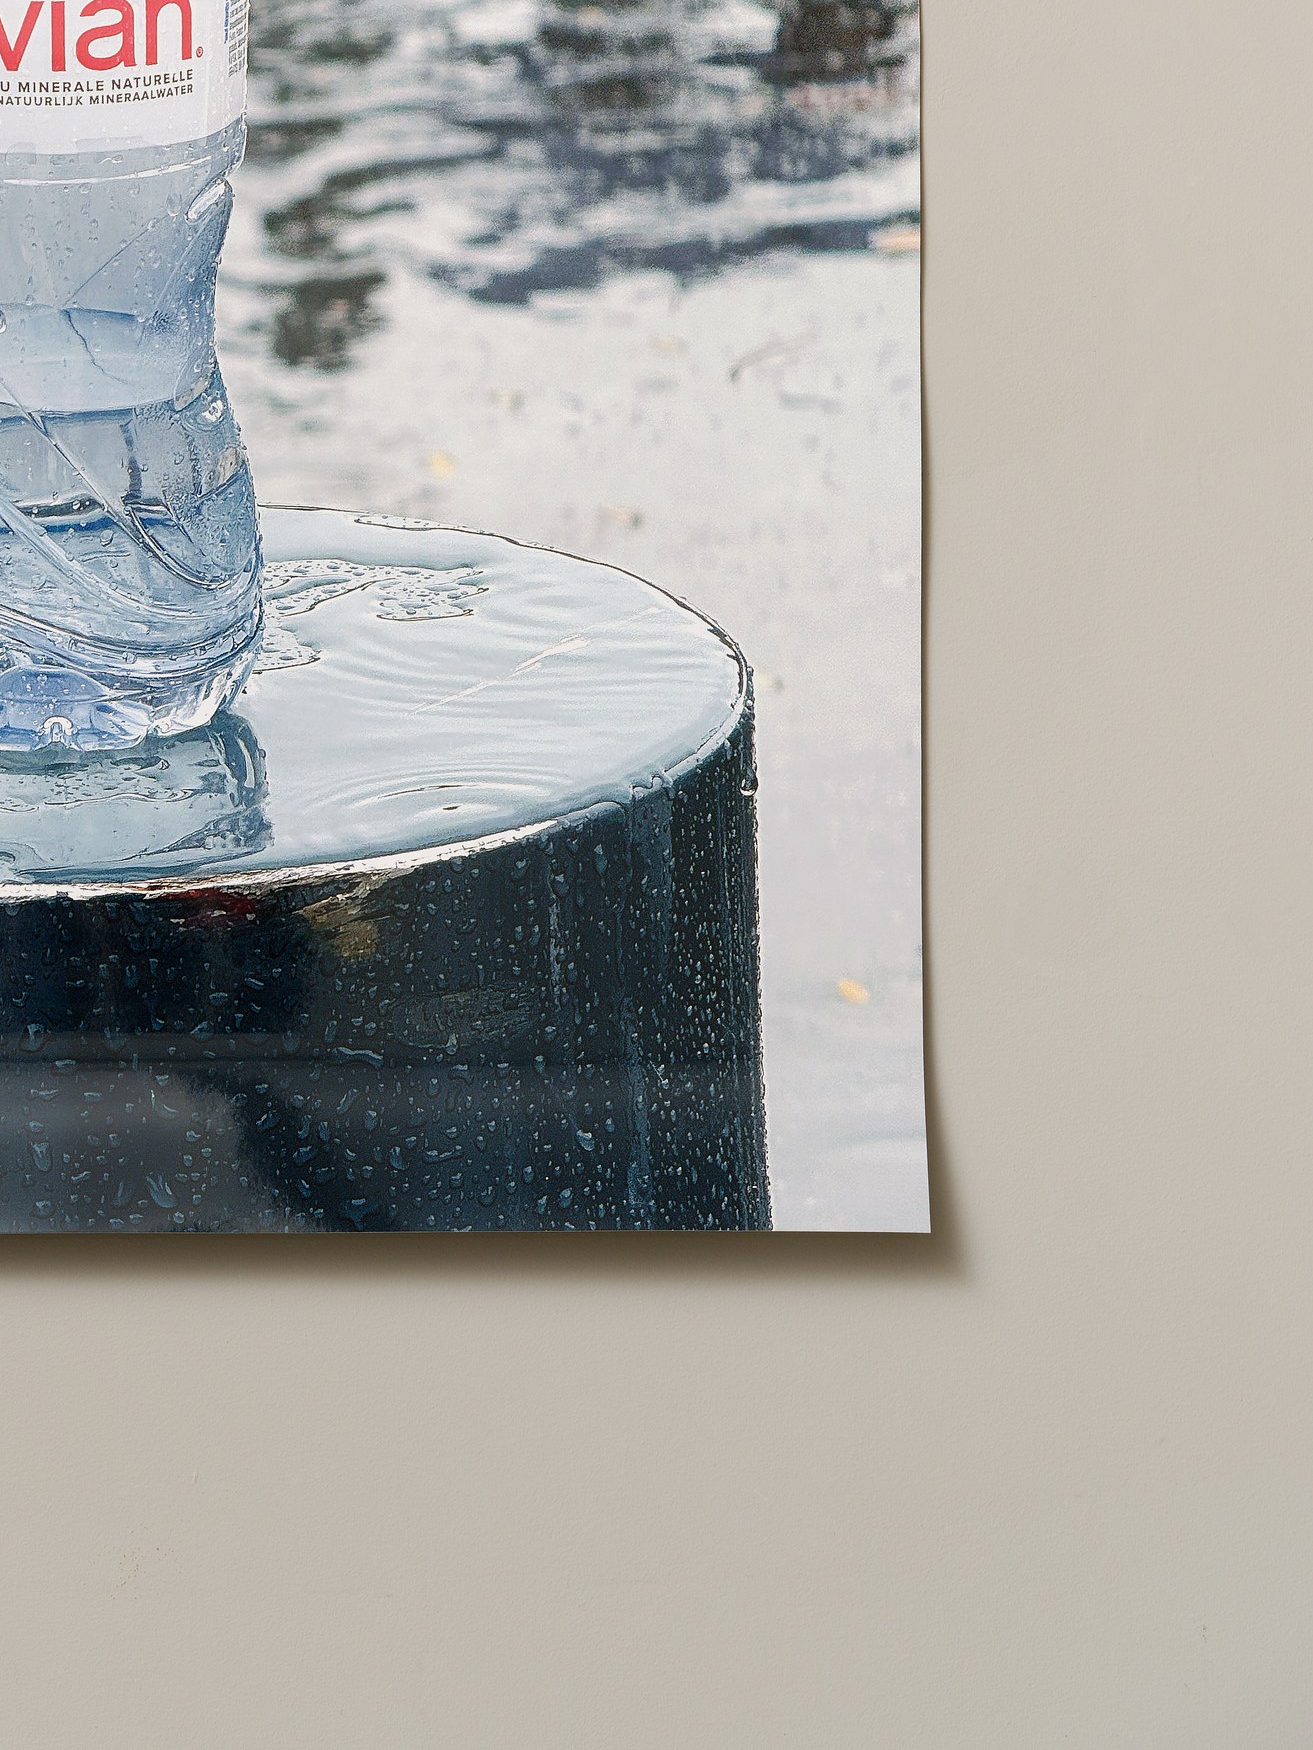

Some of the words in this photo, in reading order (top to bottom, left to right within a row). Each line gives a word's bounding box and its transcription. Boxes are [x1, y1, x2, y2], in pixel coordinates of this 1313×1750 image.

[18, 80, 104, 93] MINERALE
[111, 68, 193, 91] NATURELLE
[89, 83, 193, 105] MINERAALWATER
